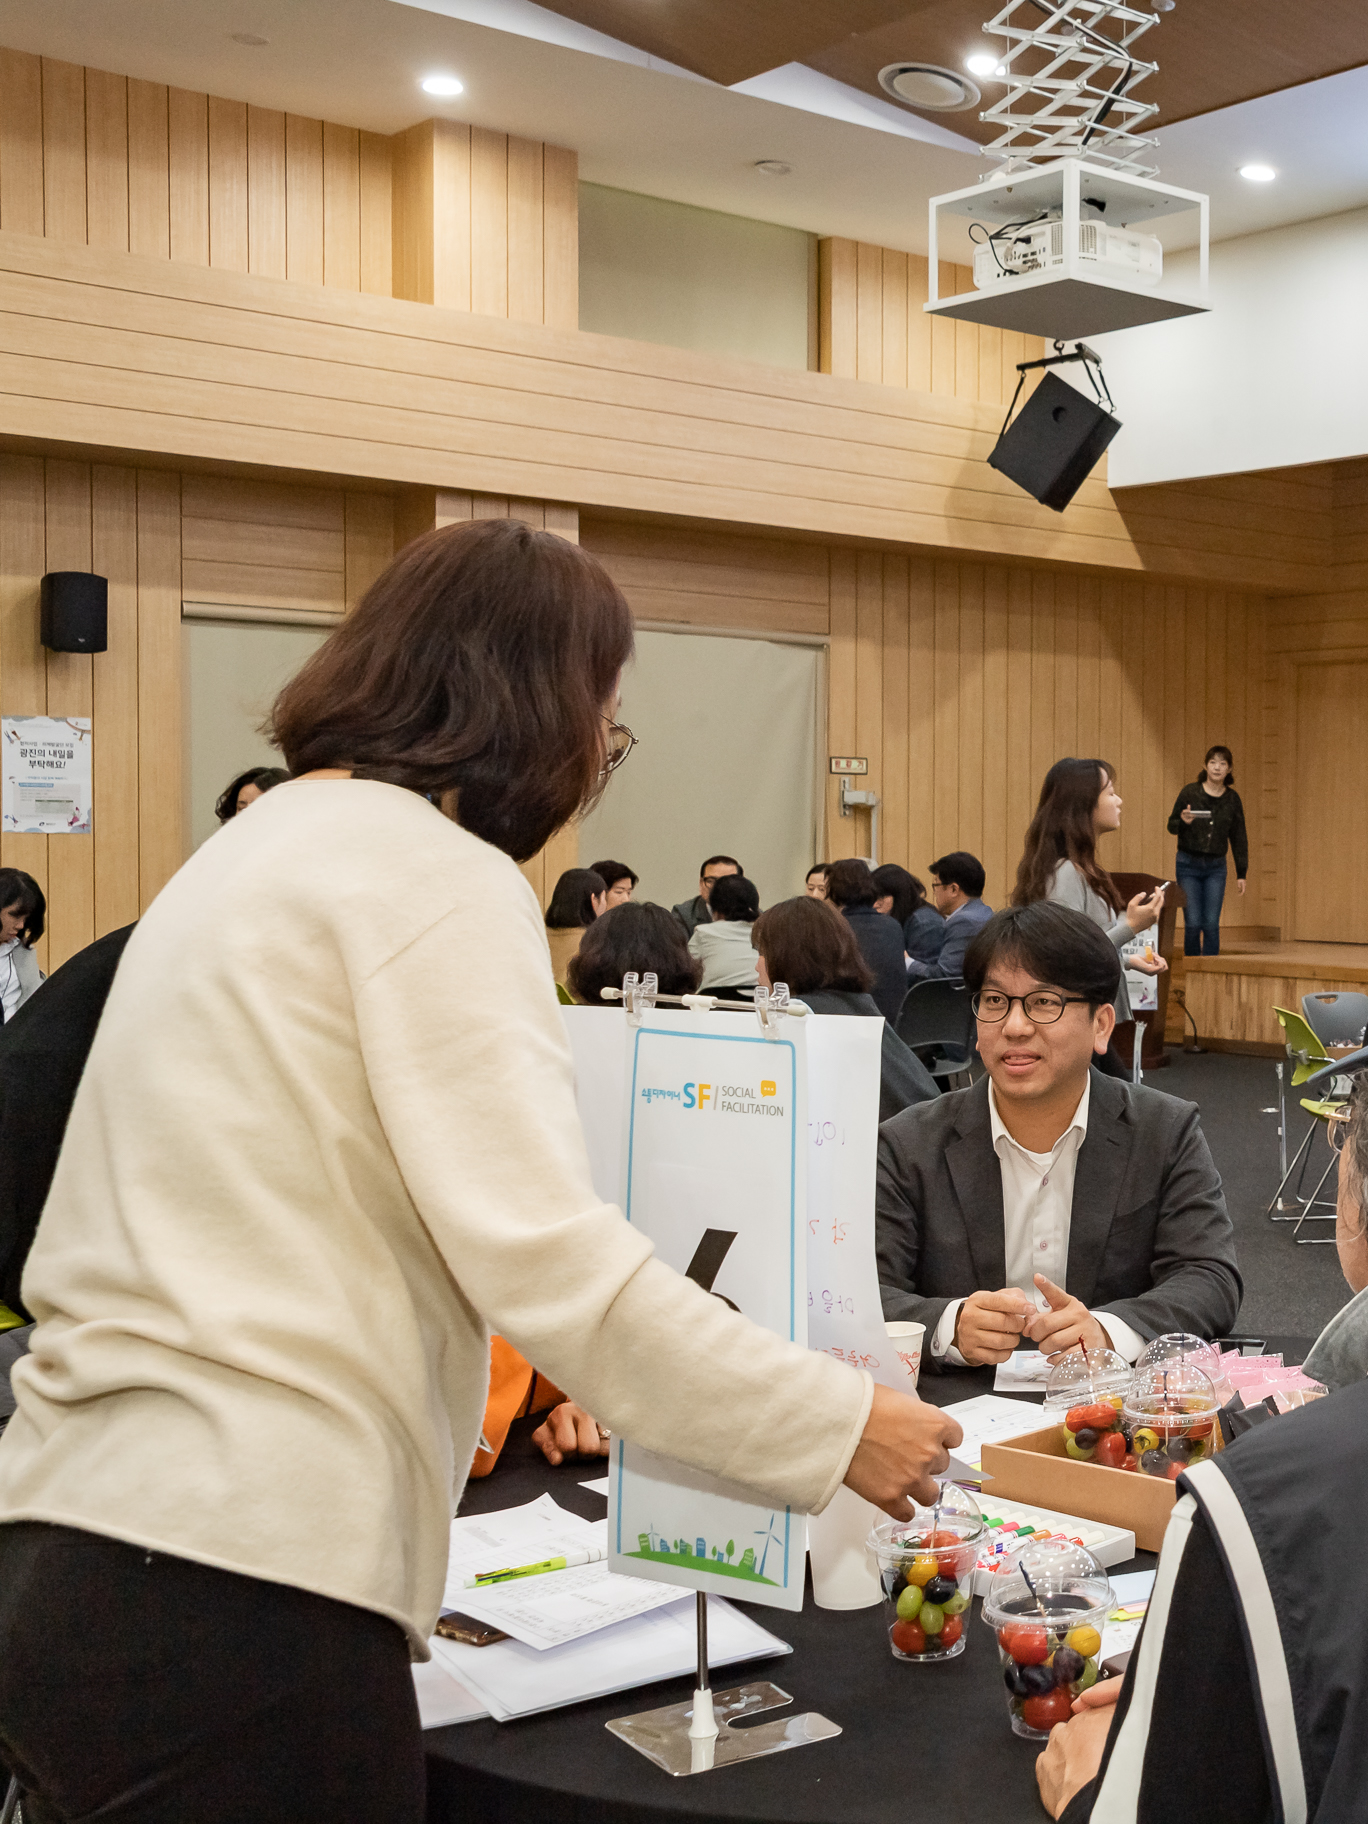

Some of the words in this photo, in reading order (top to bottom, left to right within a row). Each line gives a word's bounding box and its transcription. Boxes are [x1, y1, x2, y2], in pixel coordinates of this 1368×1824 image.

[20, 748, 46, 758] 광진의
[48, 749, 74, 760] 내일을
[29, 760, 66, 769] 부탁해요!
[641, 1087, 681, 1104] 소통디자이너
[683, 1082, 711, 1110] SF
[721, 1085, 756, 1099] SOCIAL
[721, 1100, 784, 1117] FACILITATION
